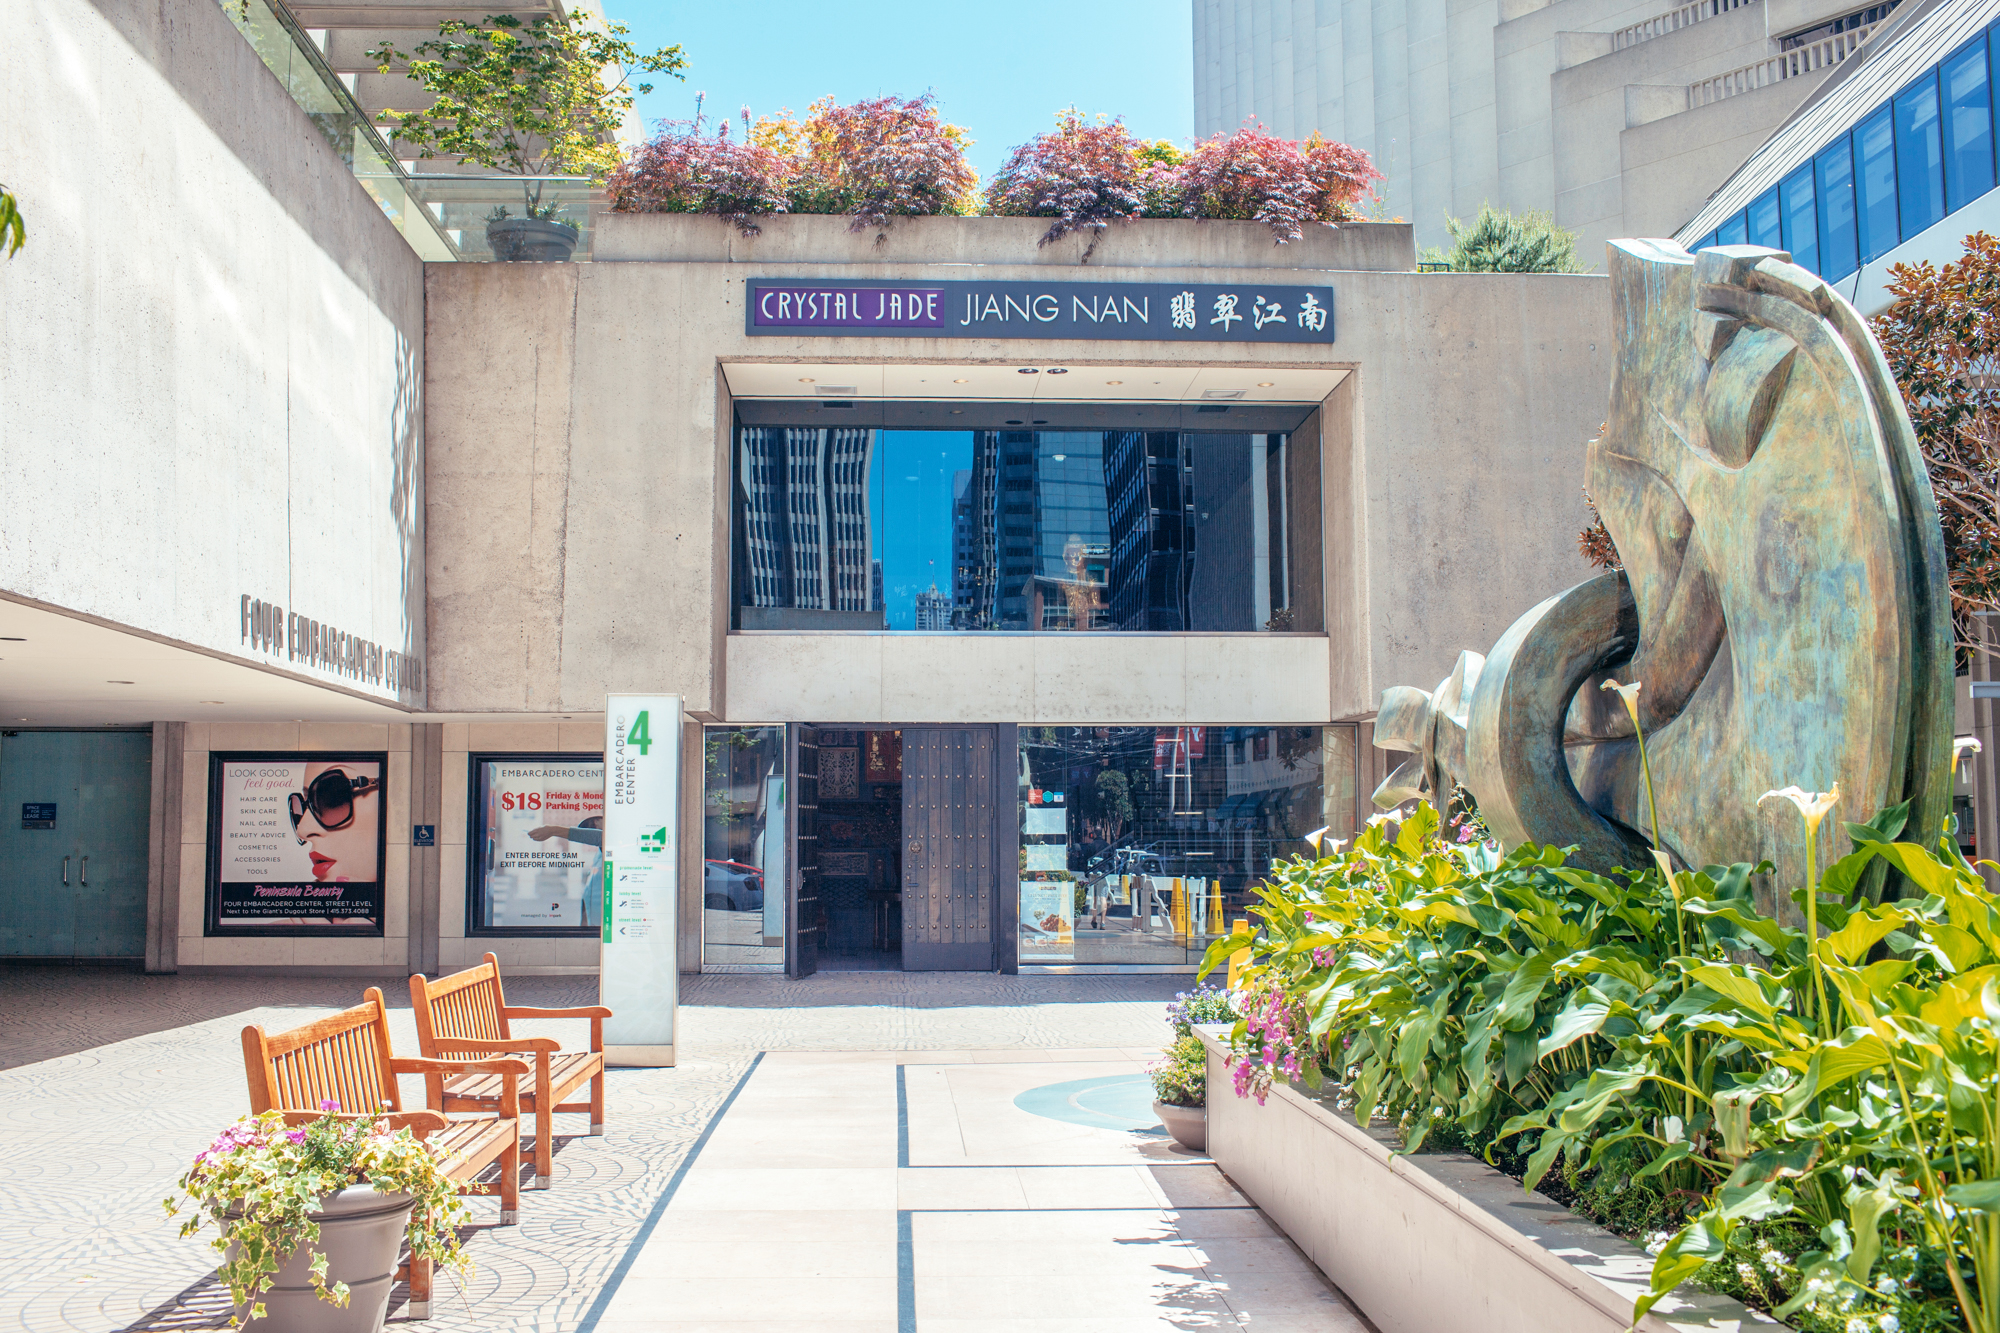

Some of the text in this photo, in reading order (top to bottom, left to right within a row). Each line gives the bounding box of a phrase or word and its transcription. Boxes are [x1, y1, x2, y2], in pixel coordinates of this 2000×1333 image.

[761, 292, 938, 321] CRYSTAL JADE
[960, 293, 1149, 326] JIANG NAN
[1170, 291, 1328, 333] 翡翠江南
[241, 594, 284, 652] FOUR
[288, 612, 383, 680] EMBARCADERO
[627, 710, 652, 755] 4
[615, 715, 625, 805] EMBARCADERO
[229, 769, 290, 777] LOOK GOOD
[243, 778, 295, 790] feel good.
[501, 769, 575, 778] EMBARCADERO
[626, 758, 635, 805] CENTER
[501, 791, 542, 812] $18
[546, 791, 571, 800] Friday
[573, 792, 580, 800] &
[546, 802, 580, 811] Parking
[253, 884, 345, 901] Peninsula Beauty
